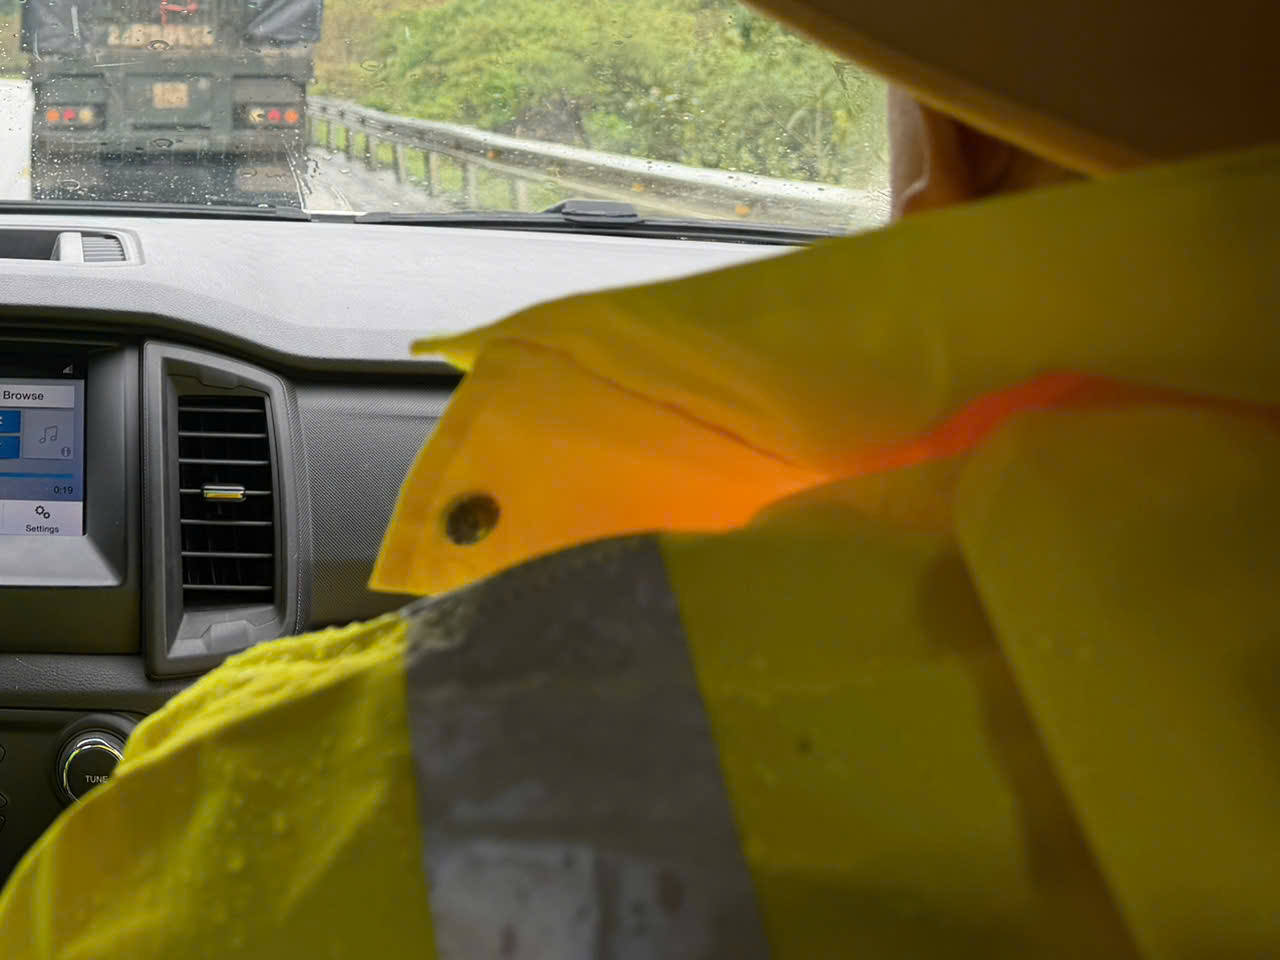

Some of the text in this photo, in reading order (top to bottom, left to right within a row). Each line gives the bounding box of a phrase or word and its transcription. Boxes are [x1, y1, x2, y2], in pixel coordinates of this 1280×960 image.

[2, 390, 44, 401] Browse
[53, 485, 74, 496] 0:19
[25, 524, 60, 535] Settings
[85, 775, 109, 784] TUNE
